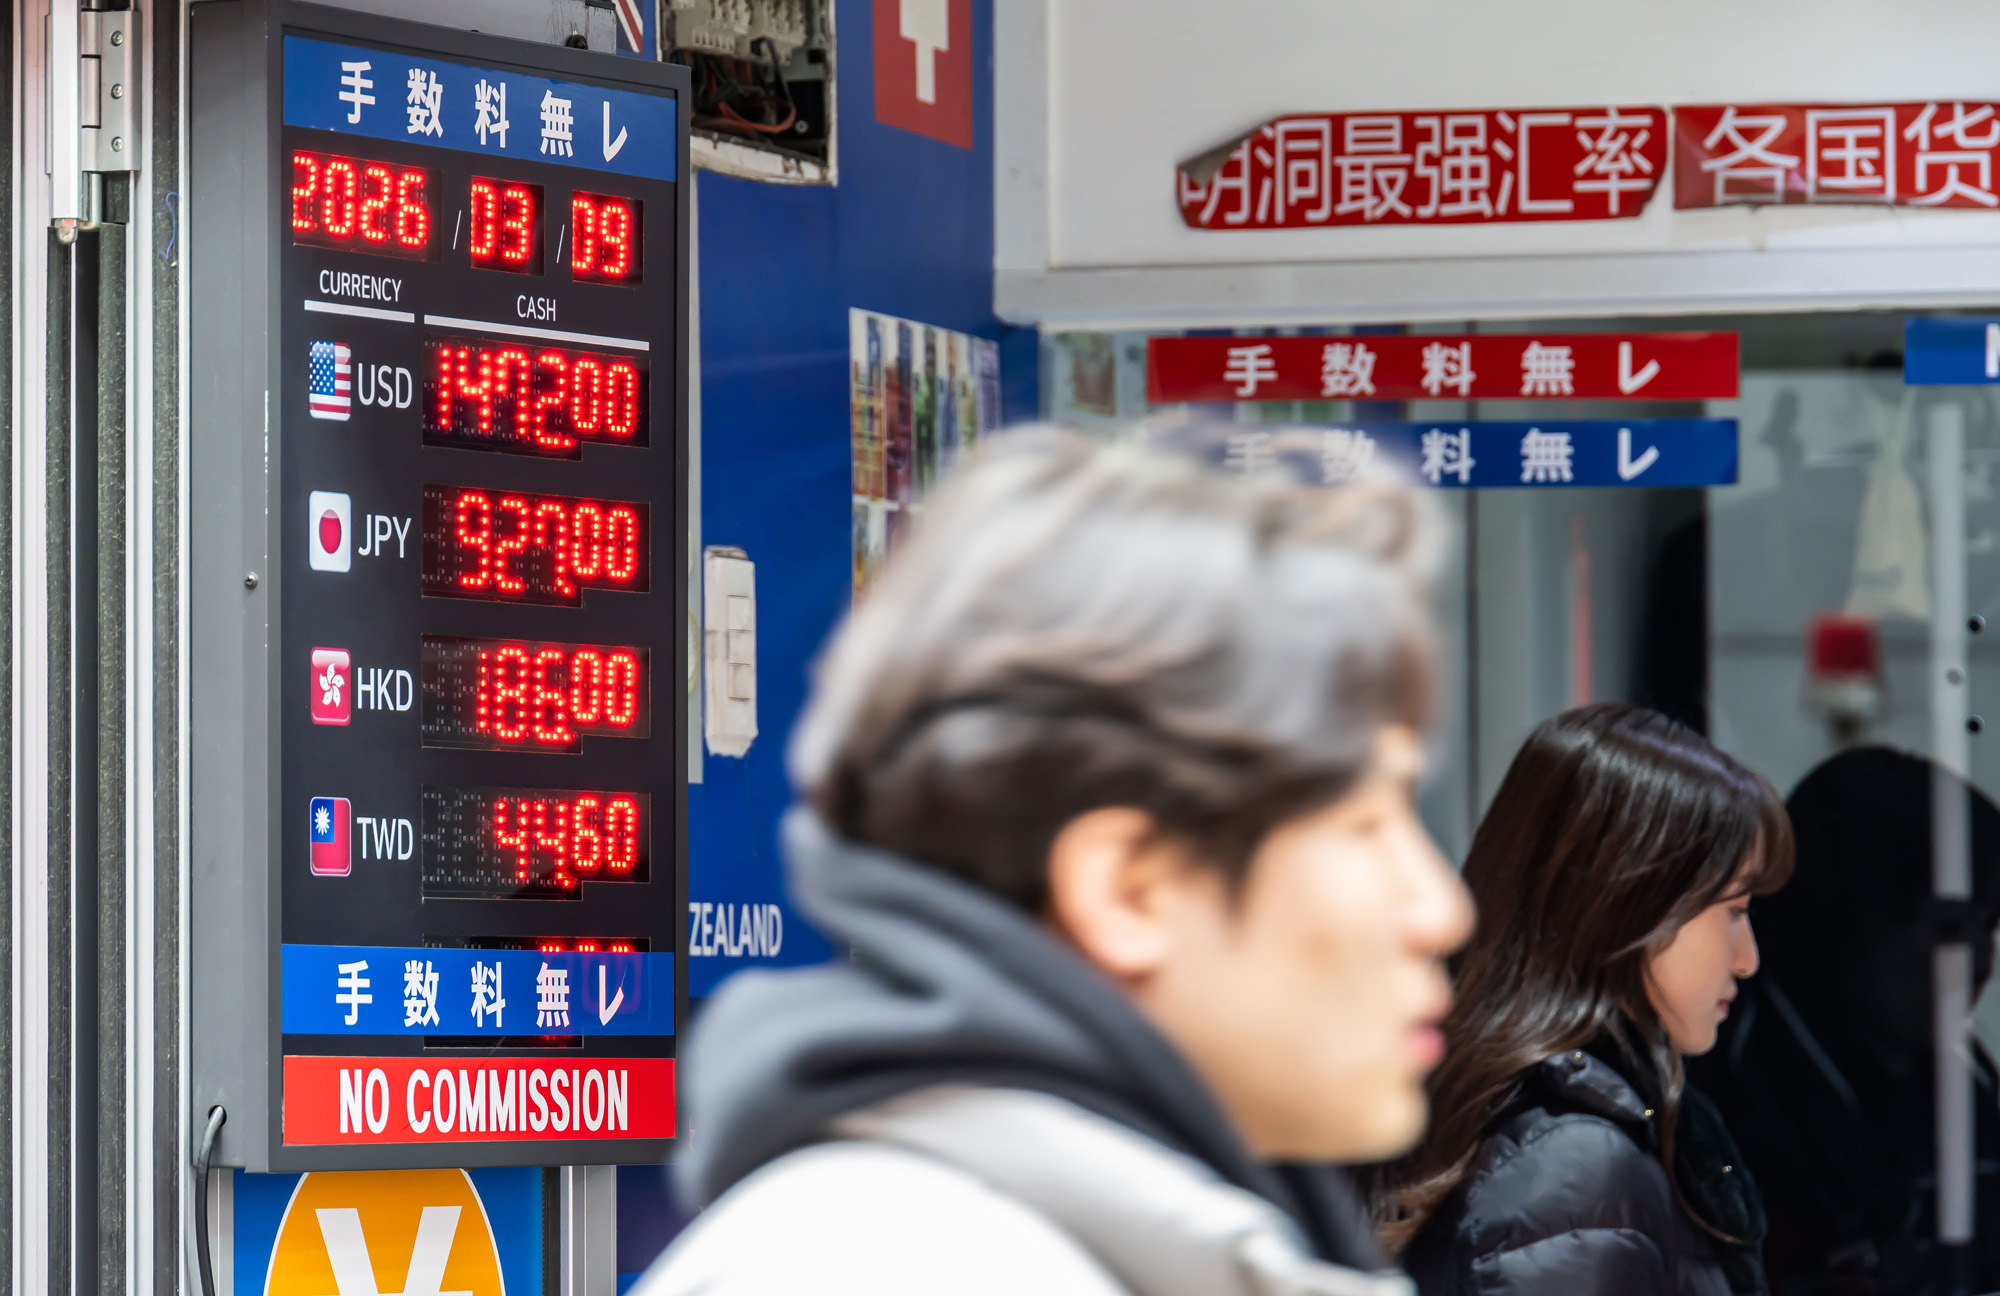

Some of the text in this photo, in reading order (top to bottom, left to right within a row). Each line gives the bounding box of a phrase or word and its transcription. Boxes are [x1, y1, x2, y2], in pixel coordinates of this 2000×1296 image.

[1700, 103, 2000, 206] 各国货
[292, 153, 428, 246] 2026
[471, 181, 531, 260] 03
[572, 197, 629, 276] 09
[319, 269, 402, 303] CURRENCY
[516, 295, 557, 322] CASH
[358, 362, 413, 409] USD
[358, 514, 412, 559] JPY
[357, 667, 413, 712] HKD
[357, 816, 414, 861] TWD
[689, 902, 783, 957] ZEALAND
[339, 1068, 629, 1134] NO COMMISSION
